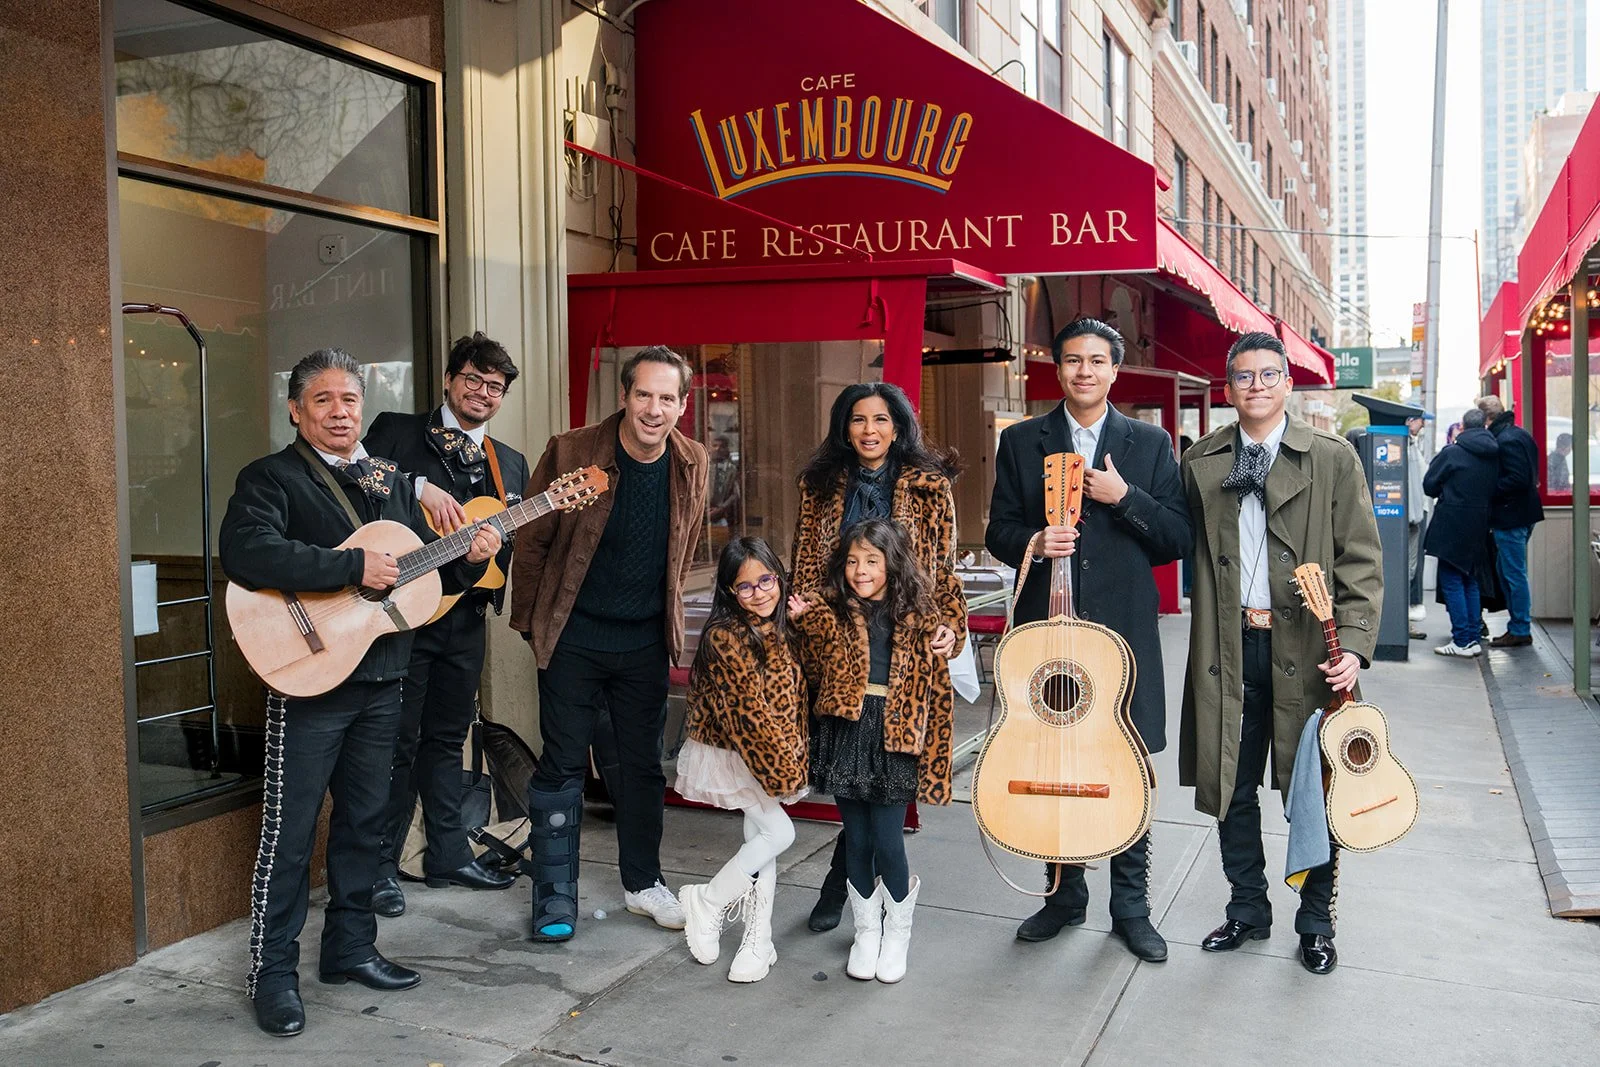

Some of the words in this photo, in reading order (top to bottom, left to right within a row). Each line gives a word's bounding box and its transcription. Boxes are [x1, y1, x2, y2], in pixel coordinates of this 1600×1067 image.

[800, 73, 856, 92] CAFE
[689, 95, 973, 200] LUXEMBOURG
[650, 229, 737, 262] CAFE
[761, 214, 1023, 258] RESTAURANT
[1049, 209, 1138, 246] BAR
